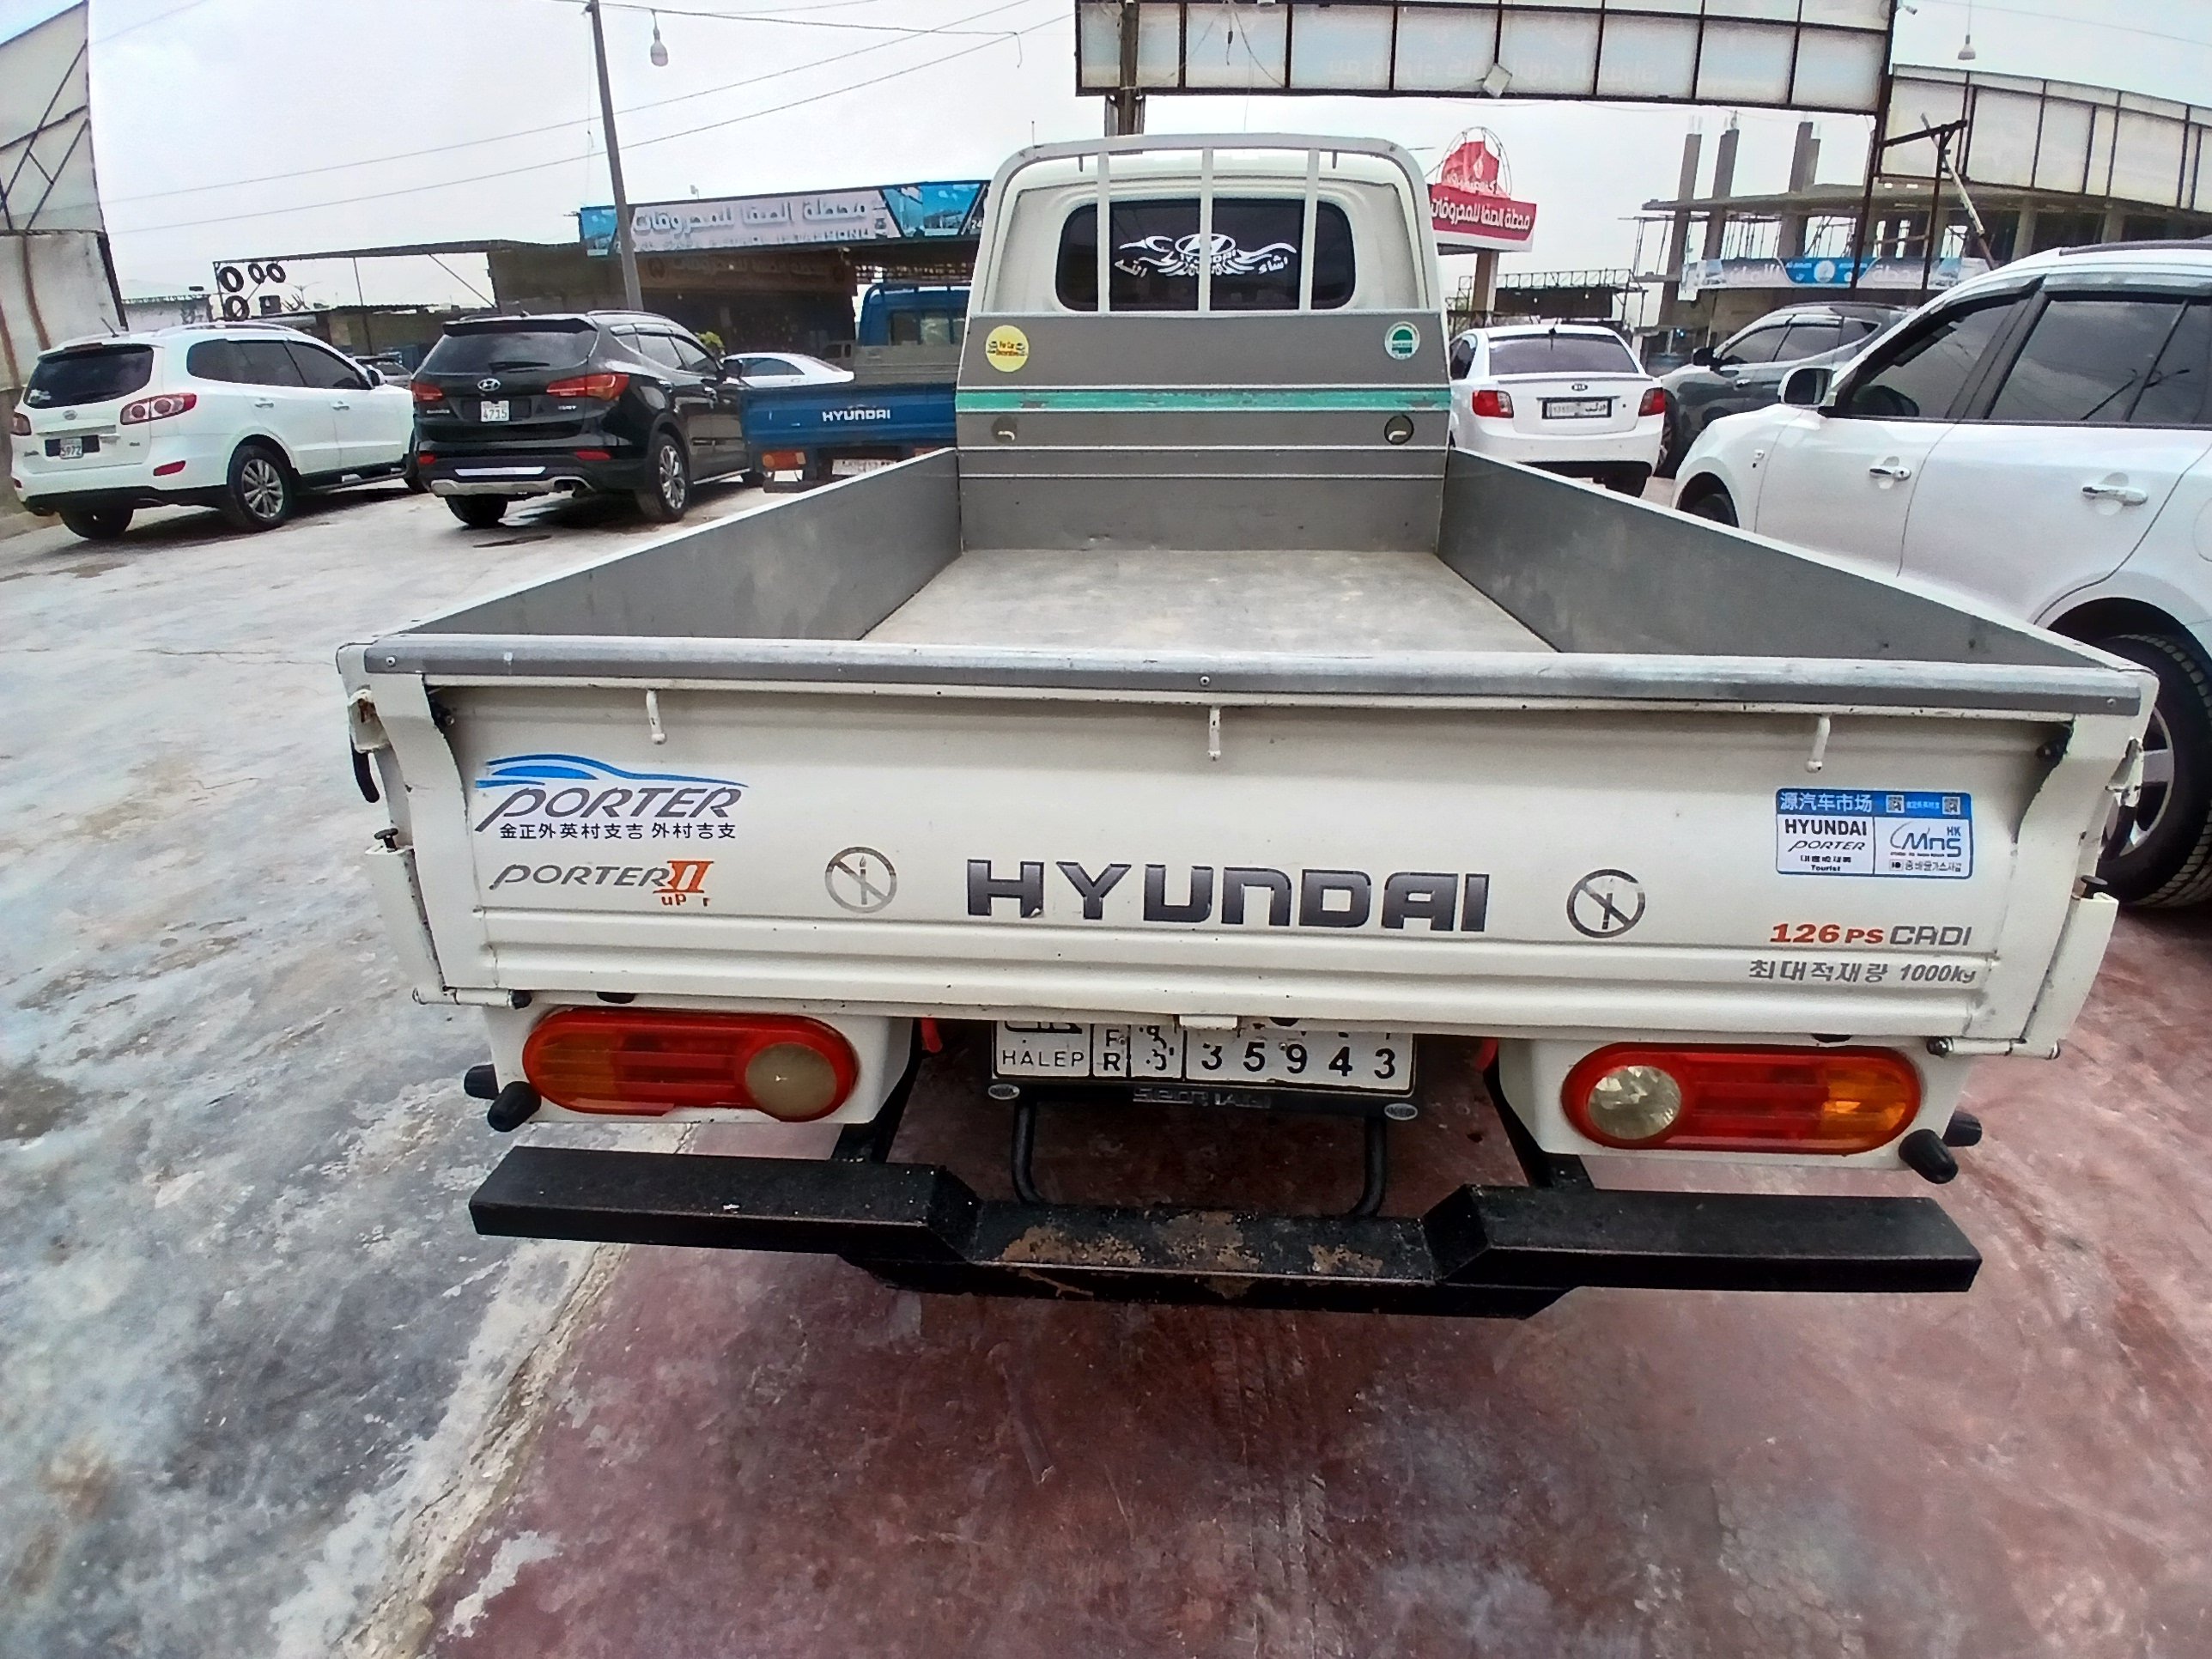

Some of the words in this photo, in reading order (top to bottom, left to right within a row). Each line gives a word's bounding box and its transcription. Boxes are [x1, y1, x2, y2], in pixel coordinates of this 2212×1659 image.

[822, 409, 891, 422] HYUNDAI
[474, 786, 742, 832] PORTER
[1780, 791, 1873, 813] 源汽车市场
[499, 822, 643, 840] 金正外英村支吉
[651, 822, 737, 840] 外村吉支
[1784, 818, 1868, 836] HYUNDAI
[1787, 840, 1866, 853] PORTER
[489, 863, 671, 890] PORTER
[966, 859, 1490, 932] HYUNDAI
[1770, 923, 1840, 944] 126
[1844, 928, 1885, 945] PS
[1748, 959, 1889, 983] 최대적재량
[1001, 1049, 1085, 1068] HALEP
[1201, 1041, 1396, 1079] 35943
